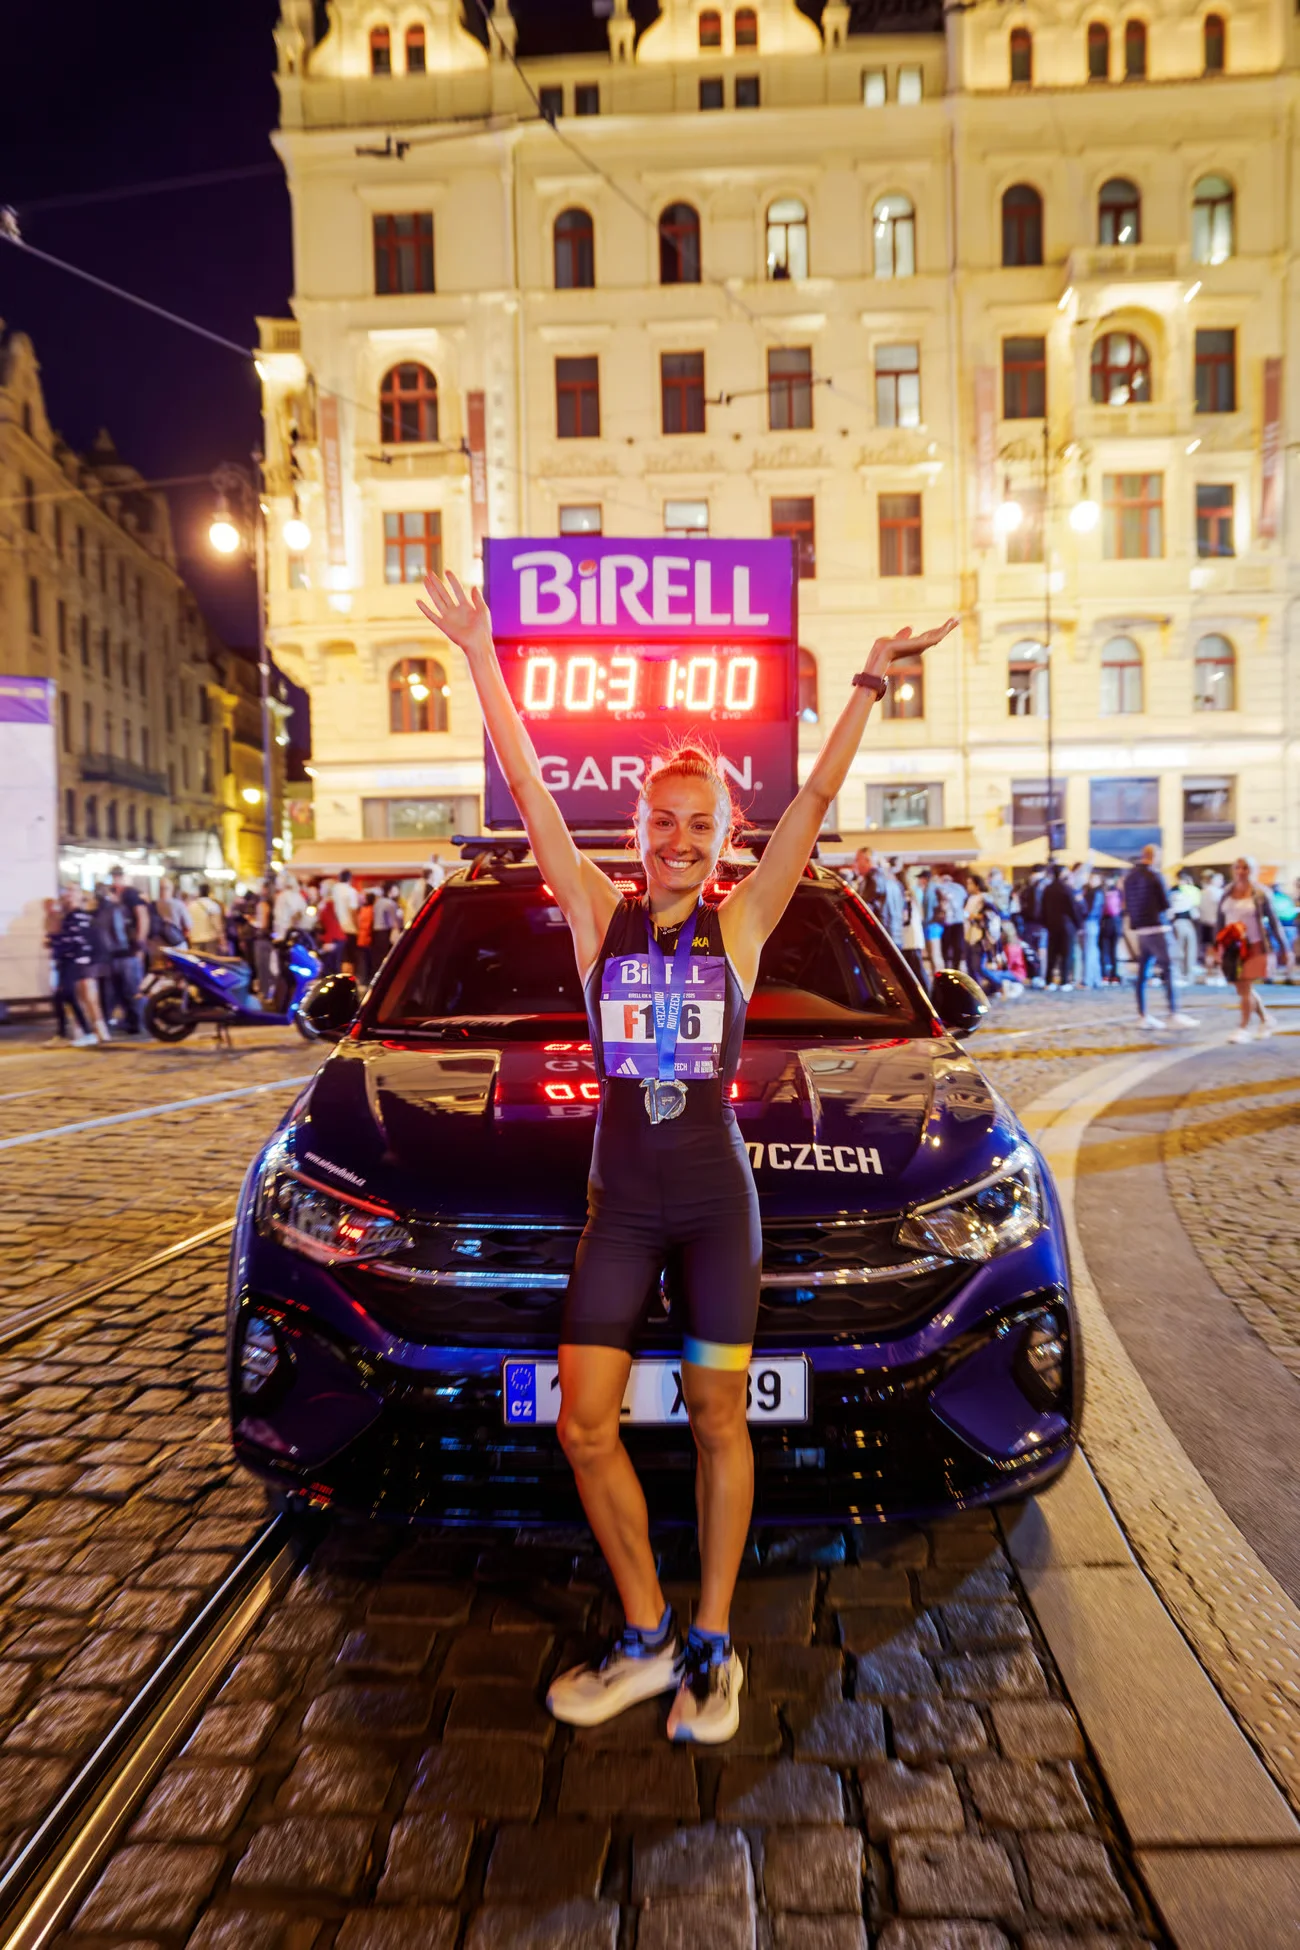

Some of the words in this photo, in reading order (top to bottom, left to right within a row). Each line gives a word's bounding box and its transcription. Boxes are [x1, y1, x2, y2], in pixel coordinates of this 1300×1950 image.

[512, 550, 770, 626] BiRELL
[623, 1003, 701, 1040] F16
[511, 1400, 533, 1417] CZ
